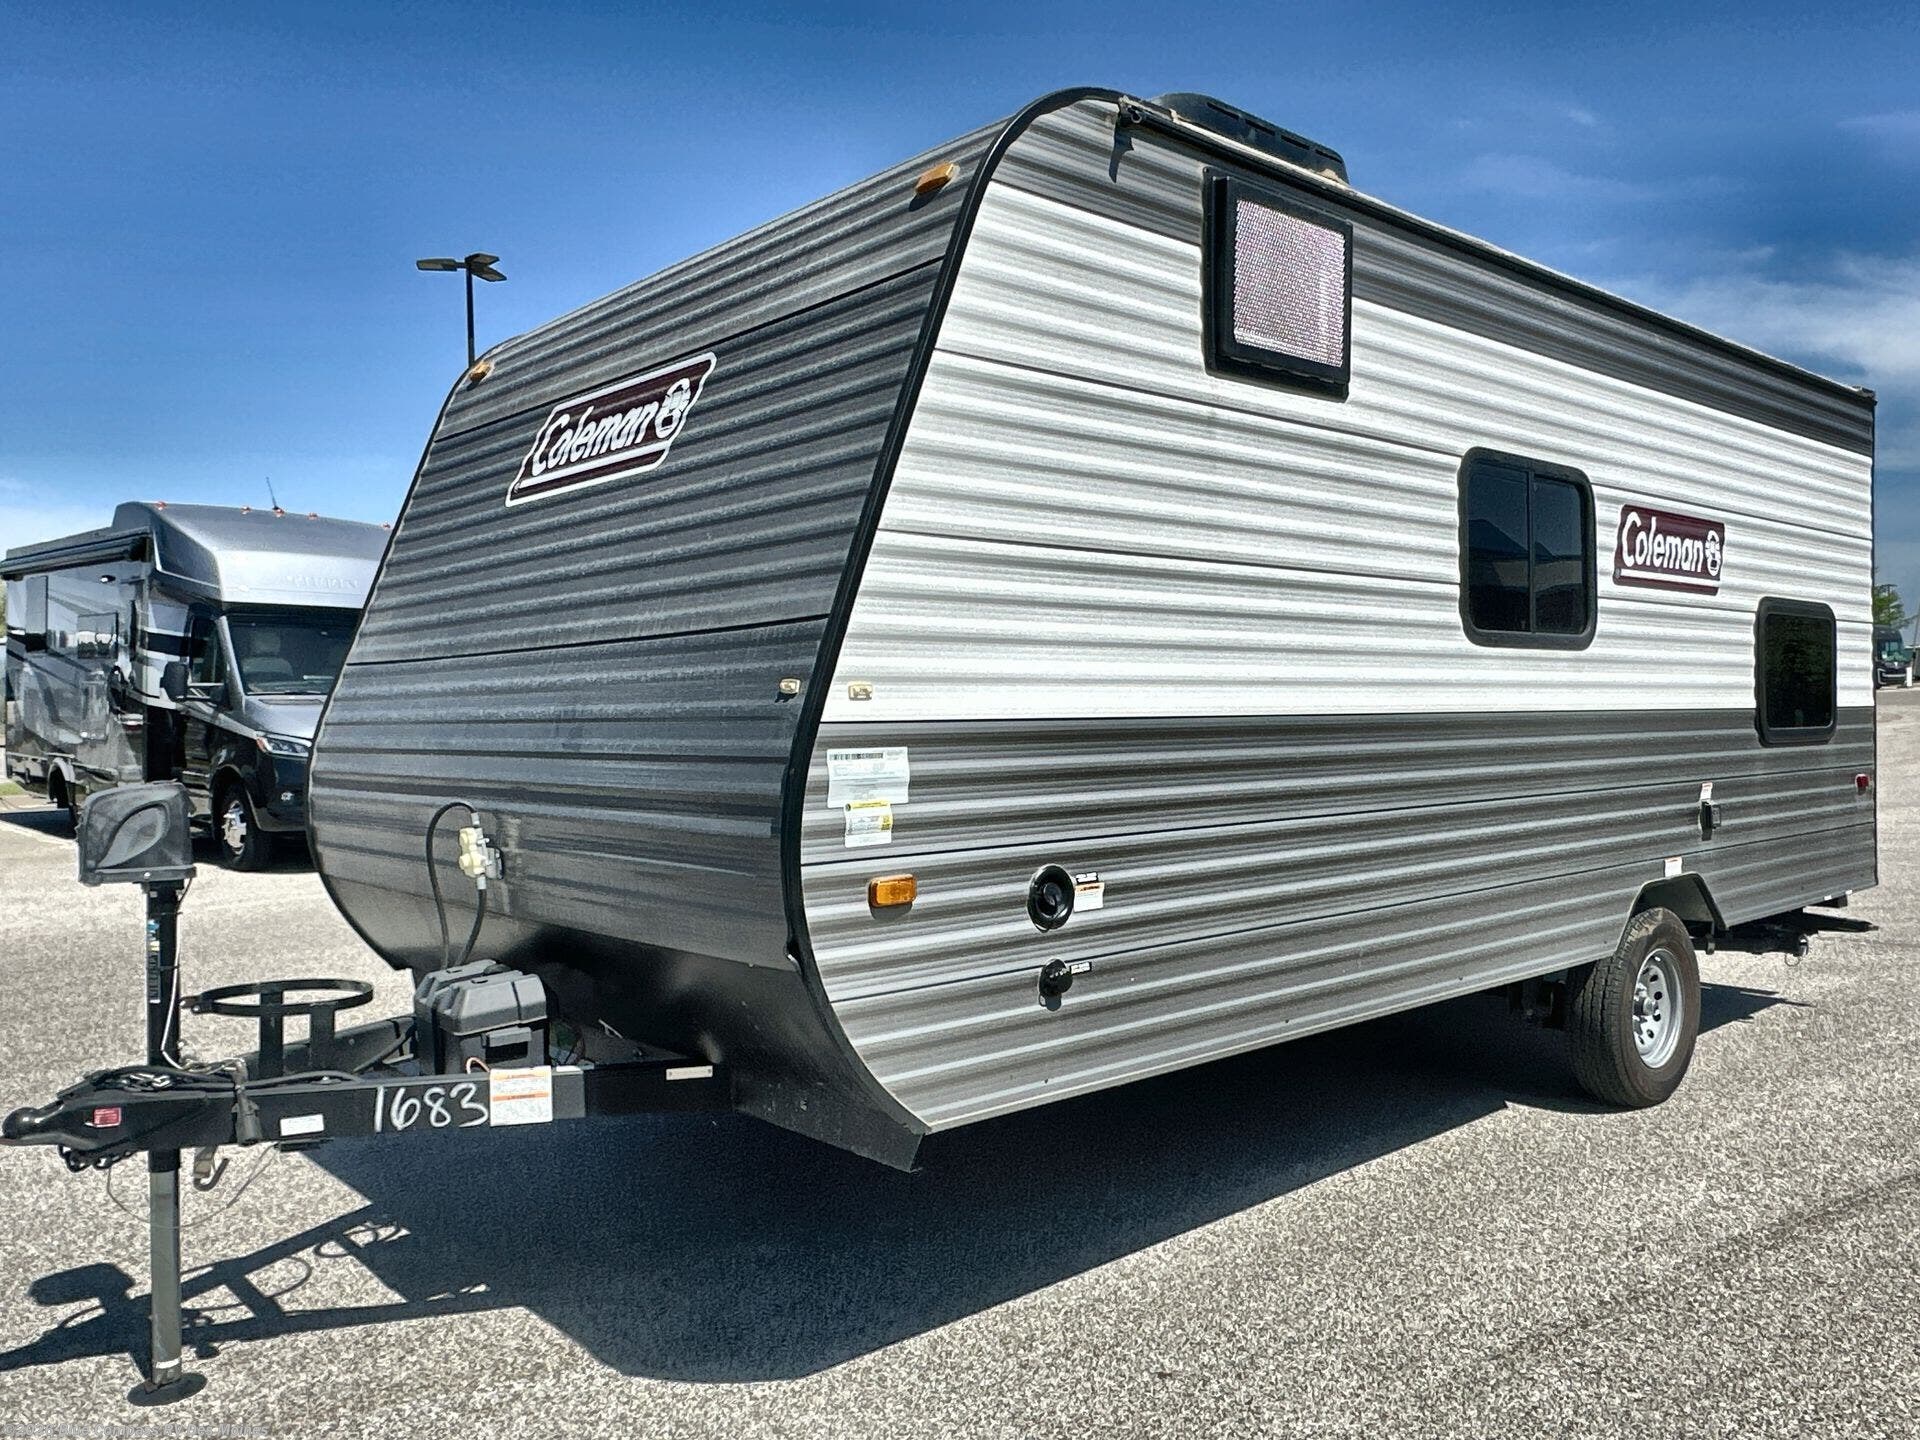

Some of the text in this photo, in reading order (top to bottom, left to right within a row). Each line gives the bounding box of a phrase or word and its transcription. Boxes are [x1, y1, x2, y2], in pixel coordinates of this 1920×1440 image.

[532, 401, 660, 476] Coleman
[1622, 511, 1704, 573] Coleman
[374, 1082, 489, 1132] 1683
